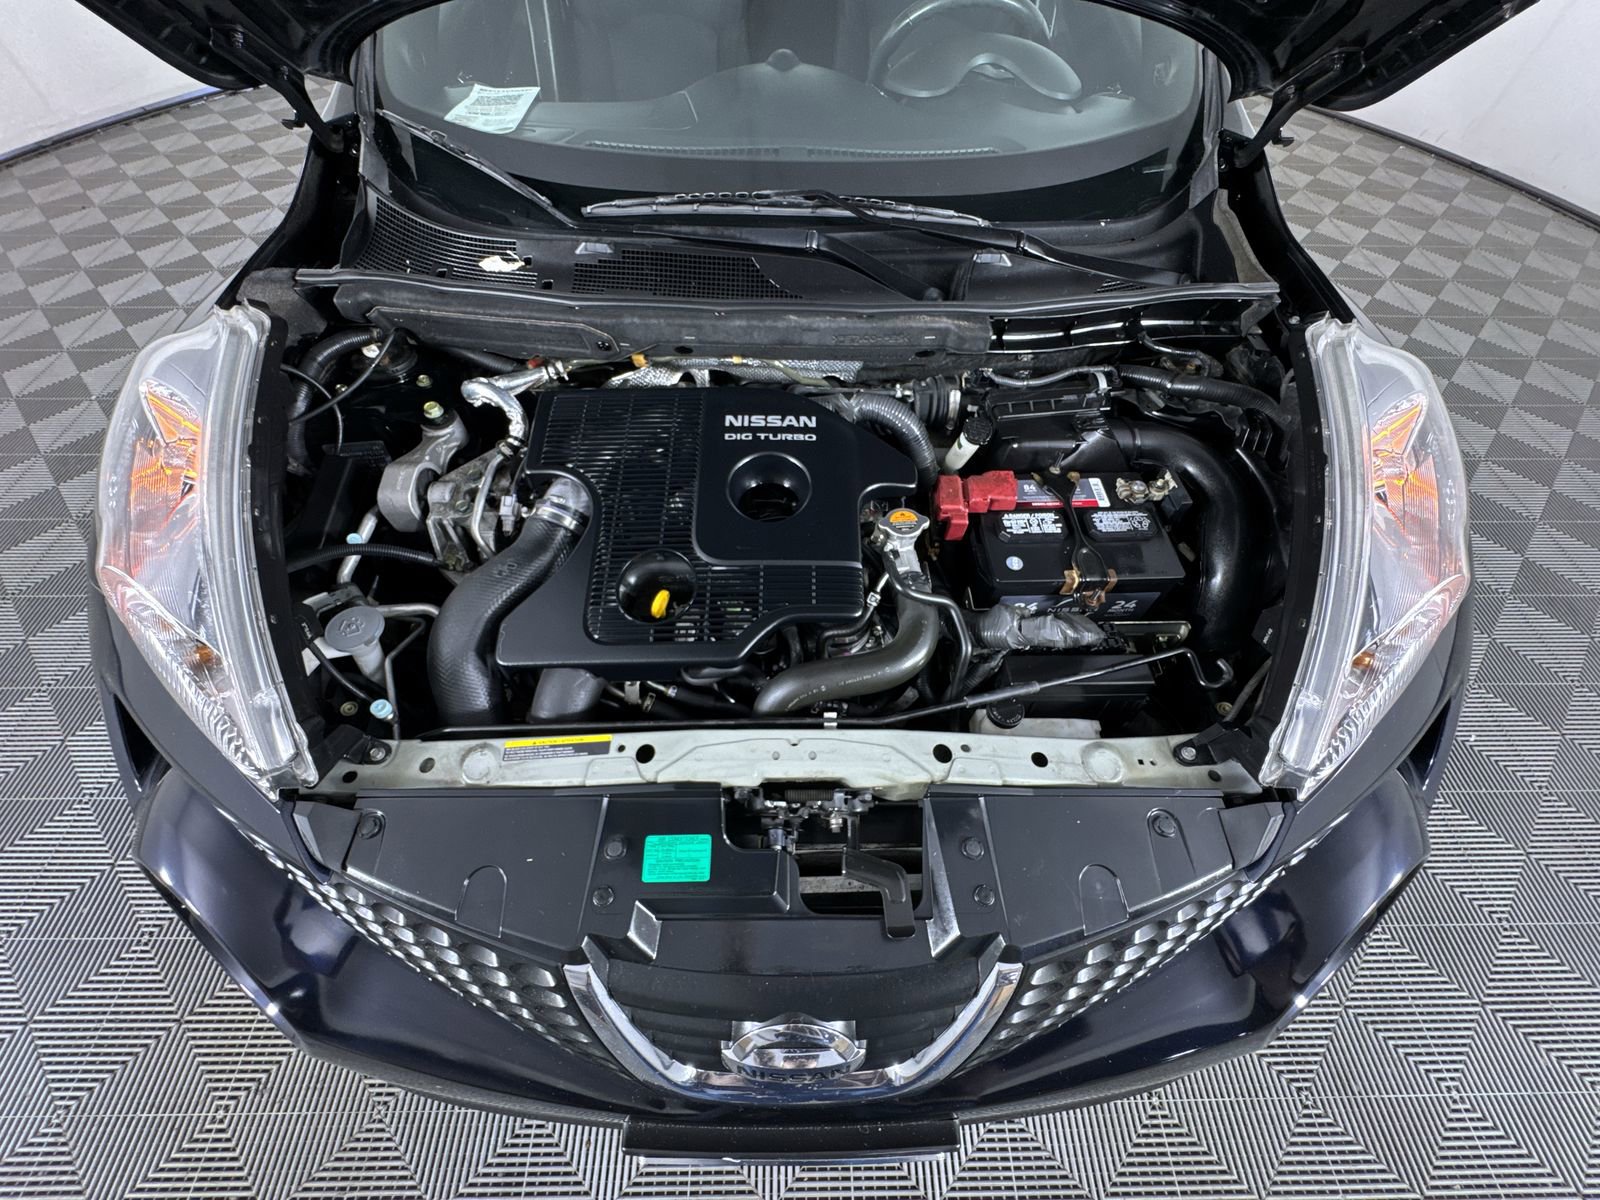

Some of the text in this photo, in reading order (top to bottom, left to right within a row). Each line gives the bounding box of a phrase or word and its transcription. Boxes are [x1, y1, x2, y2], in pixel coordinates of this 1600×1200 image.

[724, 414, 817, 428] NISSAN
[724, 433, 817, 441] DIG TURBO
[1111, 599, 1139, 609] 24
[737, 1065, 851, 1083] NISSAN
